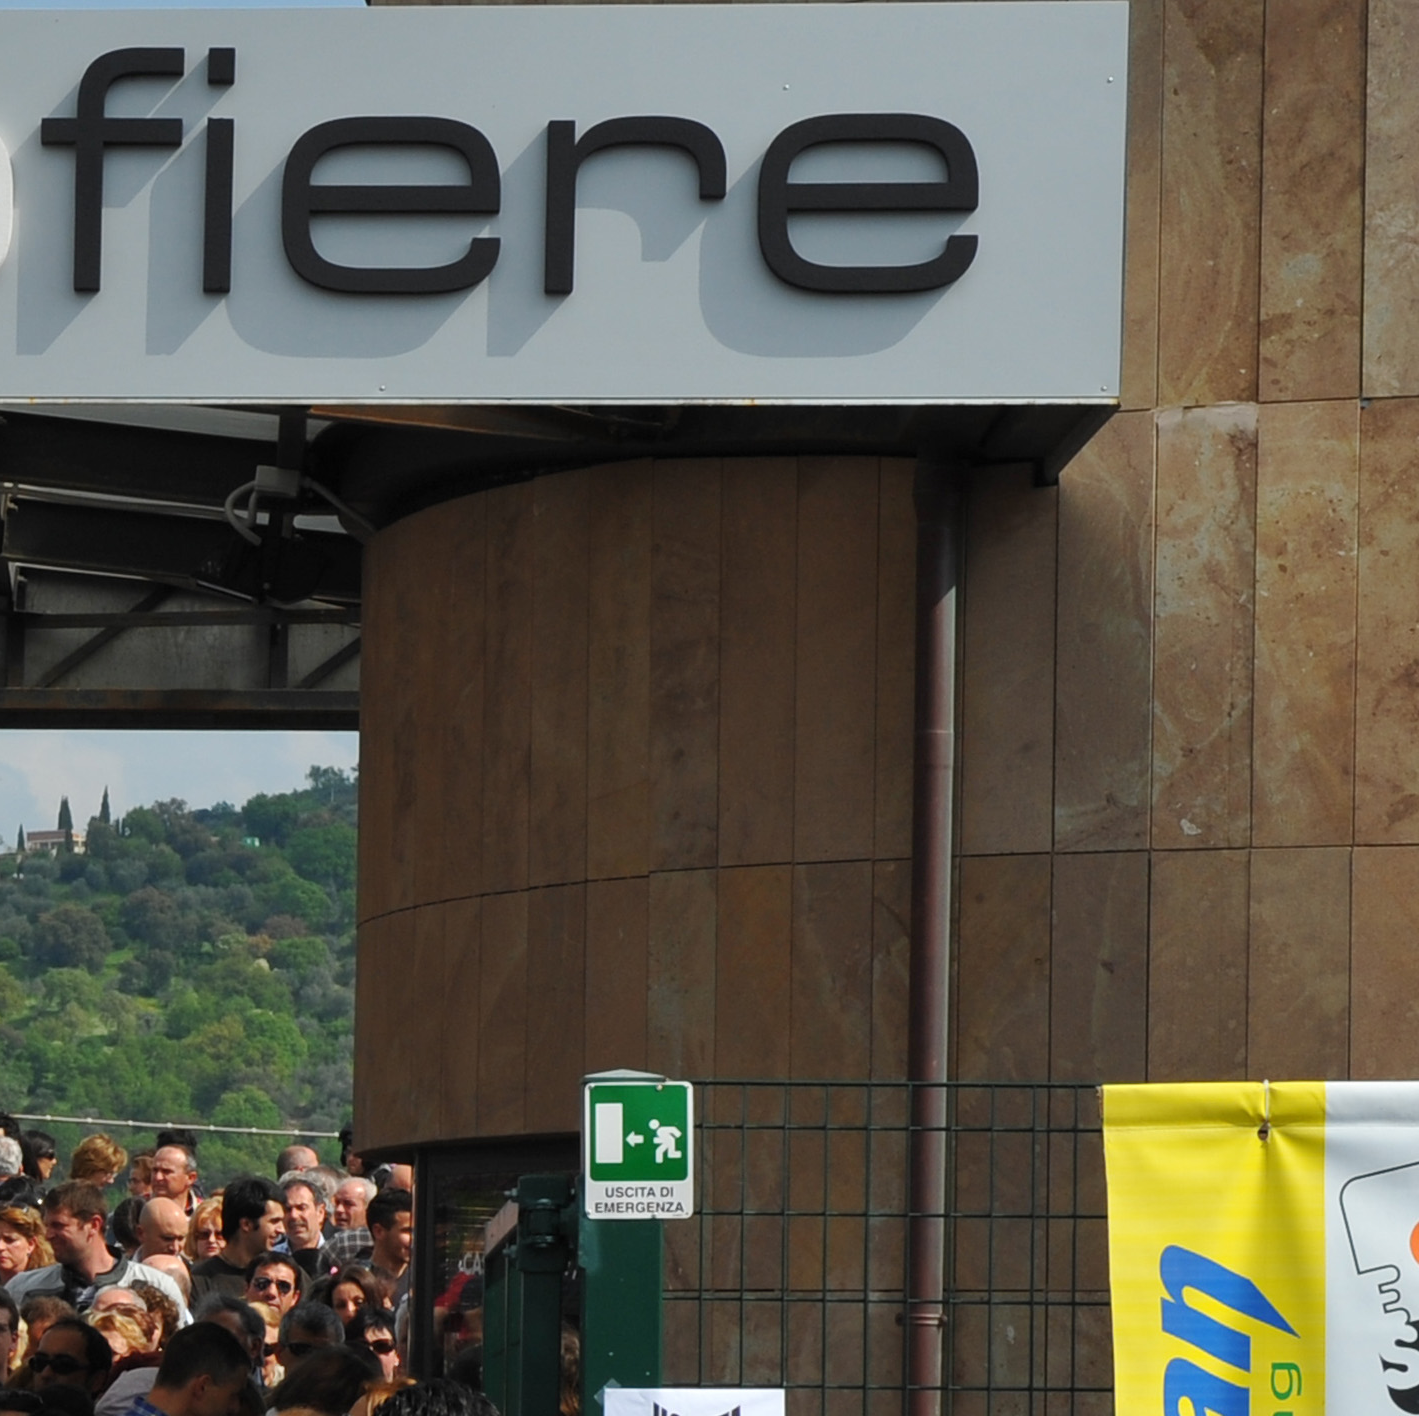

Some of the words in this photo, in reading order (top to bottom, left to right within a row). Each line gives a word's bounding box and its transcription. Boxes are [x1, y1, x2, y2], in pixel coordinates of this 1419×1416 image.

[605, 1187, 656, 1198] USCITA
[660, 1187, 674, 1198] DI
[594, 1202, 685, 1213] EMERGENZA
